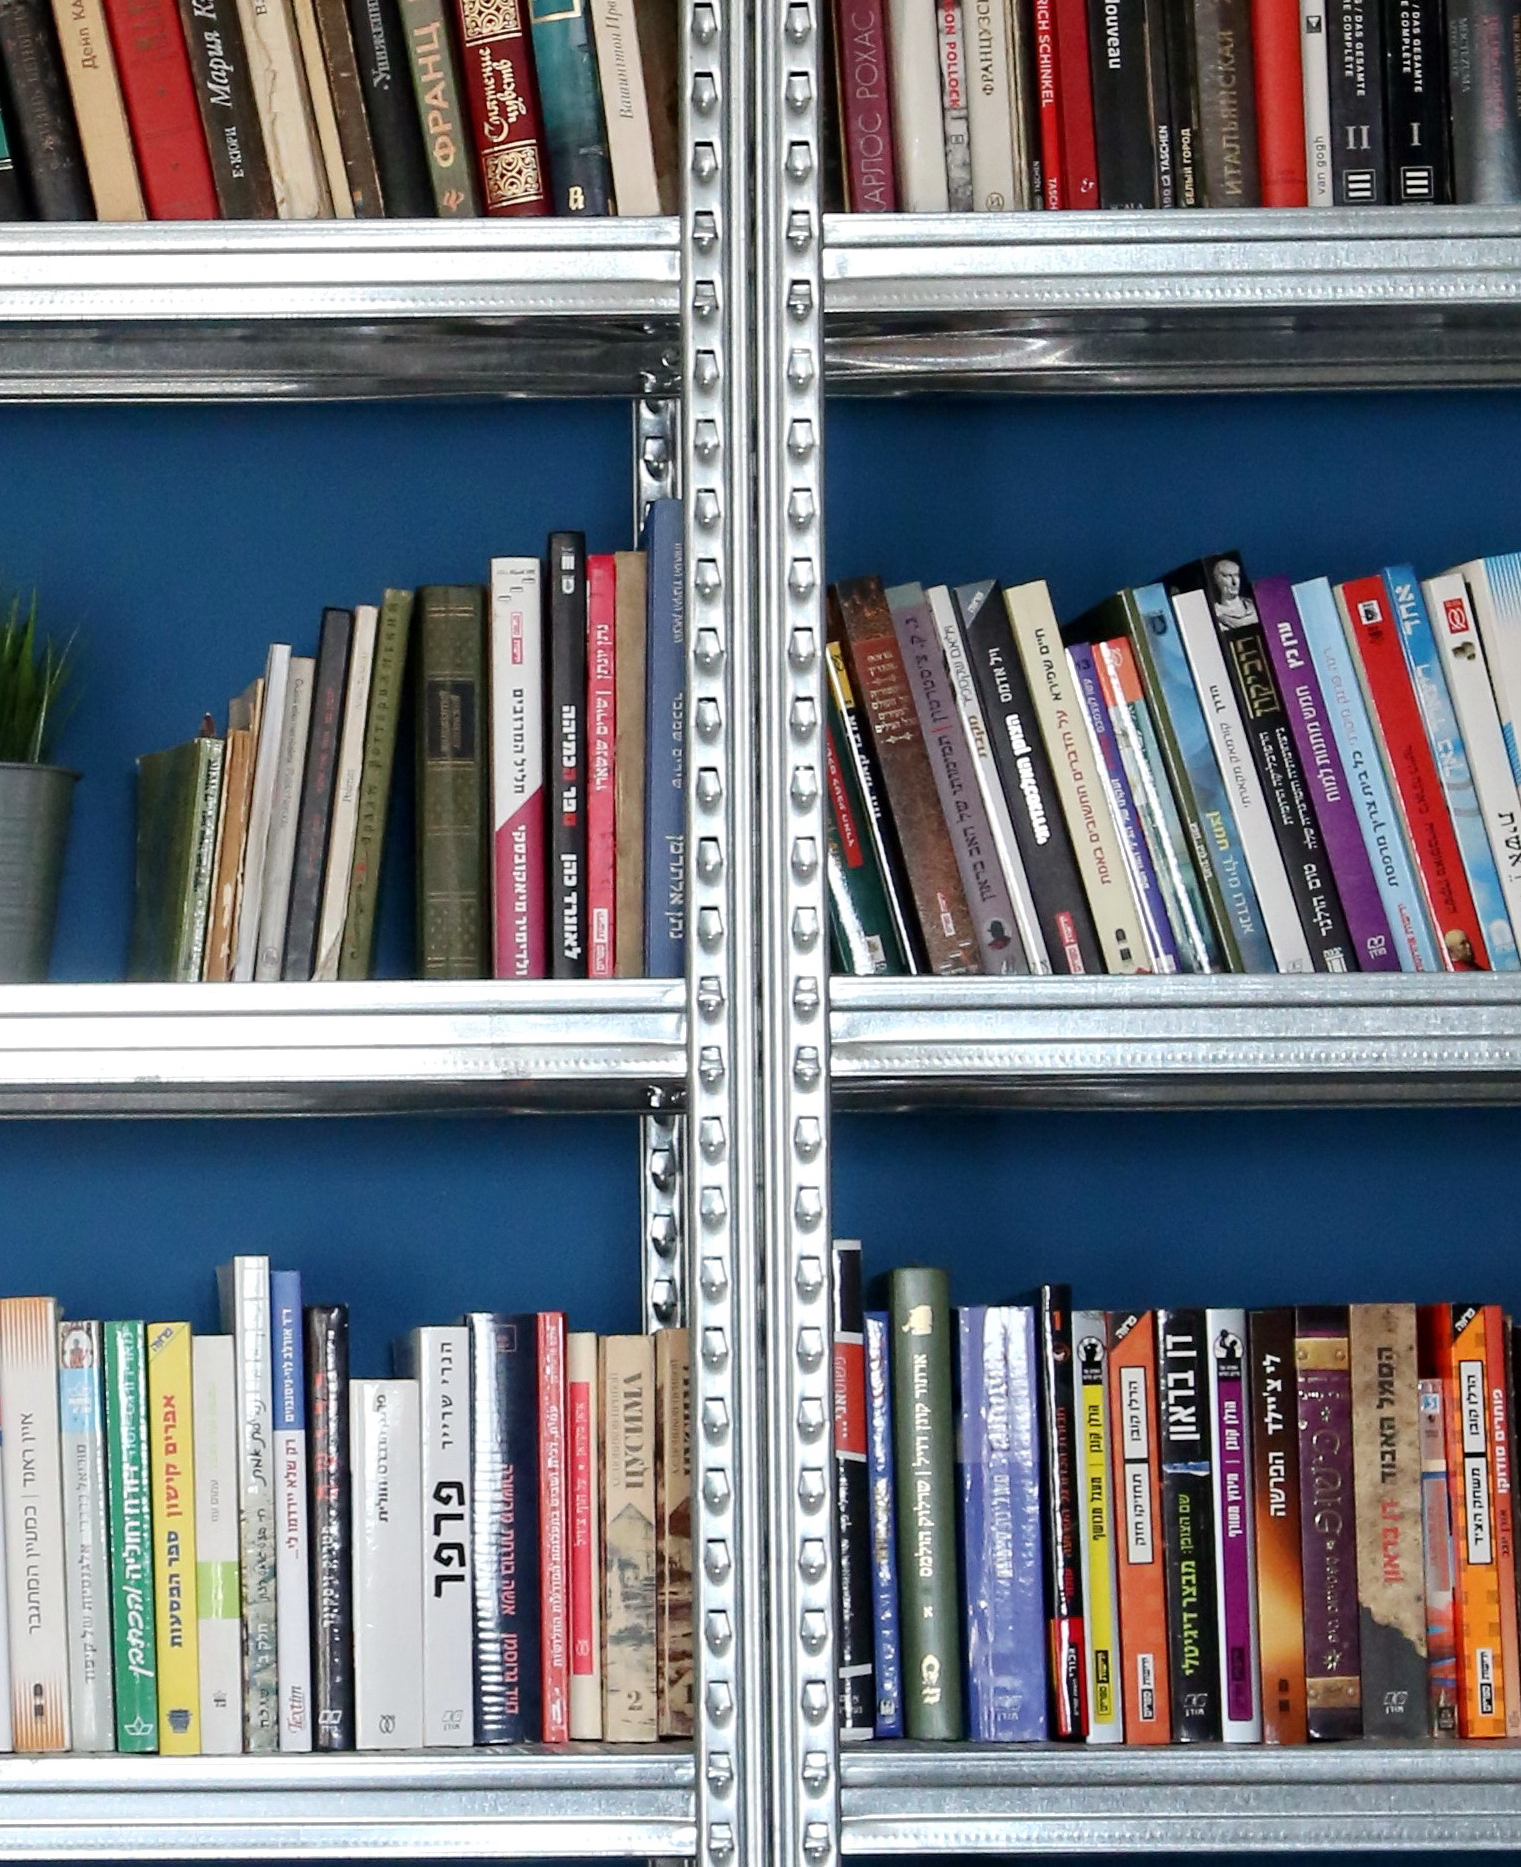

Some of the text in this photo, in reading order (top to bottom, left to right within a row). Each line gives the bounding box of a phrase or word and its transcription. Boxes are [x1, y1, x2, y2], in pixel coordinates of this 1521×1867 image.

[1411, 12, 1422, 35] DAS
[203, 30, 231, 107] Мария
[852, 11, 879, 99] РОХАС
[945, 41, 960, 108] POLLOCK
[1037, 35, 1054, 107] SCHINKEL
[1412, 39, 1424, 93] GESAMTE
[413, 21, 456, 168] ФРАНЦ
[1157, 125, 1171, 172] TASCHEN
[1313, 135, 1329, 195] van gogh
[594, 623, 610, 647] נתן
[1033, 628, 1051, 655] חיים
[1277, 622, 1295, 645] ערן
[1286, 648, 1304, 668] כץ
[594, 651, 612, 680] יונתן
[989, 647, 1012, 702] ויל אדמס
[1041, 660, 1062, 701] שפירא
[594, 697, 609, 735] שירים
[1055, 710, 1069, 728] על
[1295, 685, 1319, 719] חמש
[1062, 731, 1084, 782] הדברים
[1305, 721, 1331, 764] מתנות
[1352, 751, 1365, 769] כל
[1356, 771, 1374, 796] בית
[1076, 786, 1100, 843] החשובים
[1362, 800, 1386, 832] צריך
[560, 854, 580, 960] לאונרד כהן
[1129, 1380, 1143, 1442] הרלן קובן
[1166, 1334, 1200, 1442] דן בראון
[1377, 1347, 1397, 1483] הסמל האבוד
[623, 1372, 645, 1489] ЦУСИМА
[432, 1342, 466, 1598] הנרי שרייר פרפר
[1269, 1451, 1286, 1517] הפרשה
[19, 1412, 42, 1634] איין ראנד כמעיין המתגבר
[162, 1395, 183, 1647] אפרים קישון ספר המסעות
[915, 1480, 934, 1577] שרלוק הולמס
[1133, 1473, 1146, 1546] תחזיקו חזק
[1470, 1468, 1484, 1546] משחק הציד
[1180, 1561, 1199, 1675] מבצר דיגיטלי
